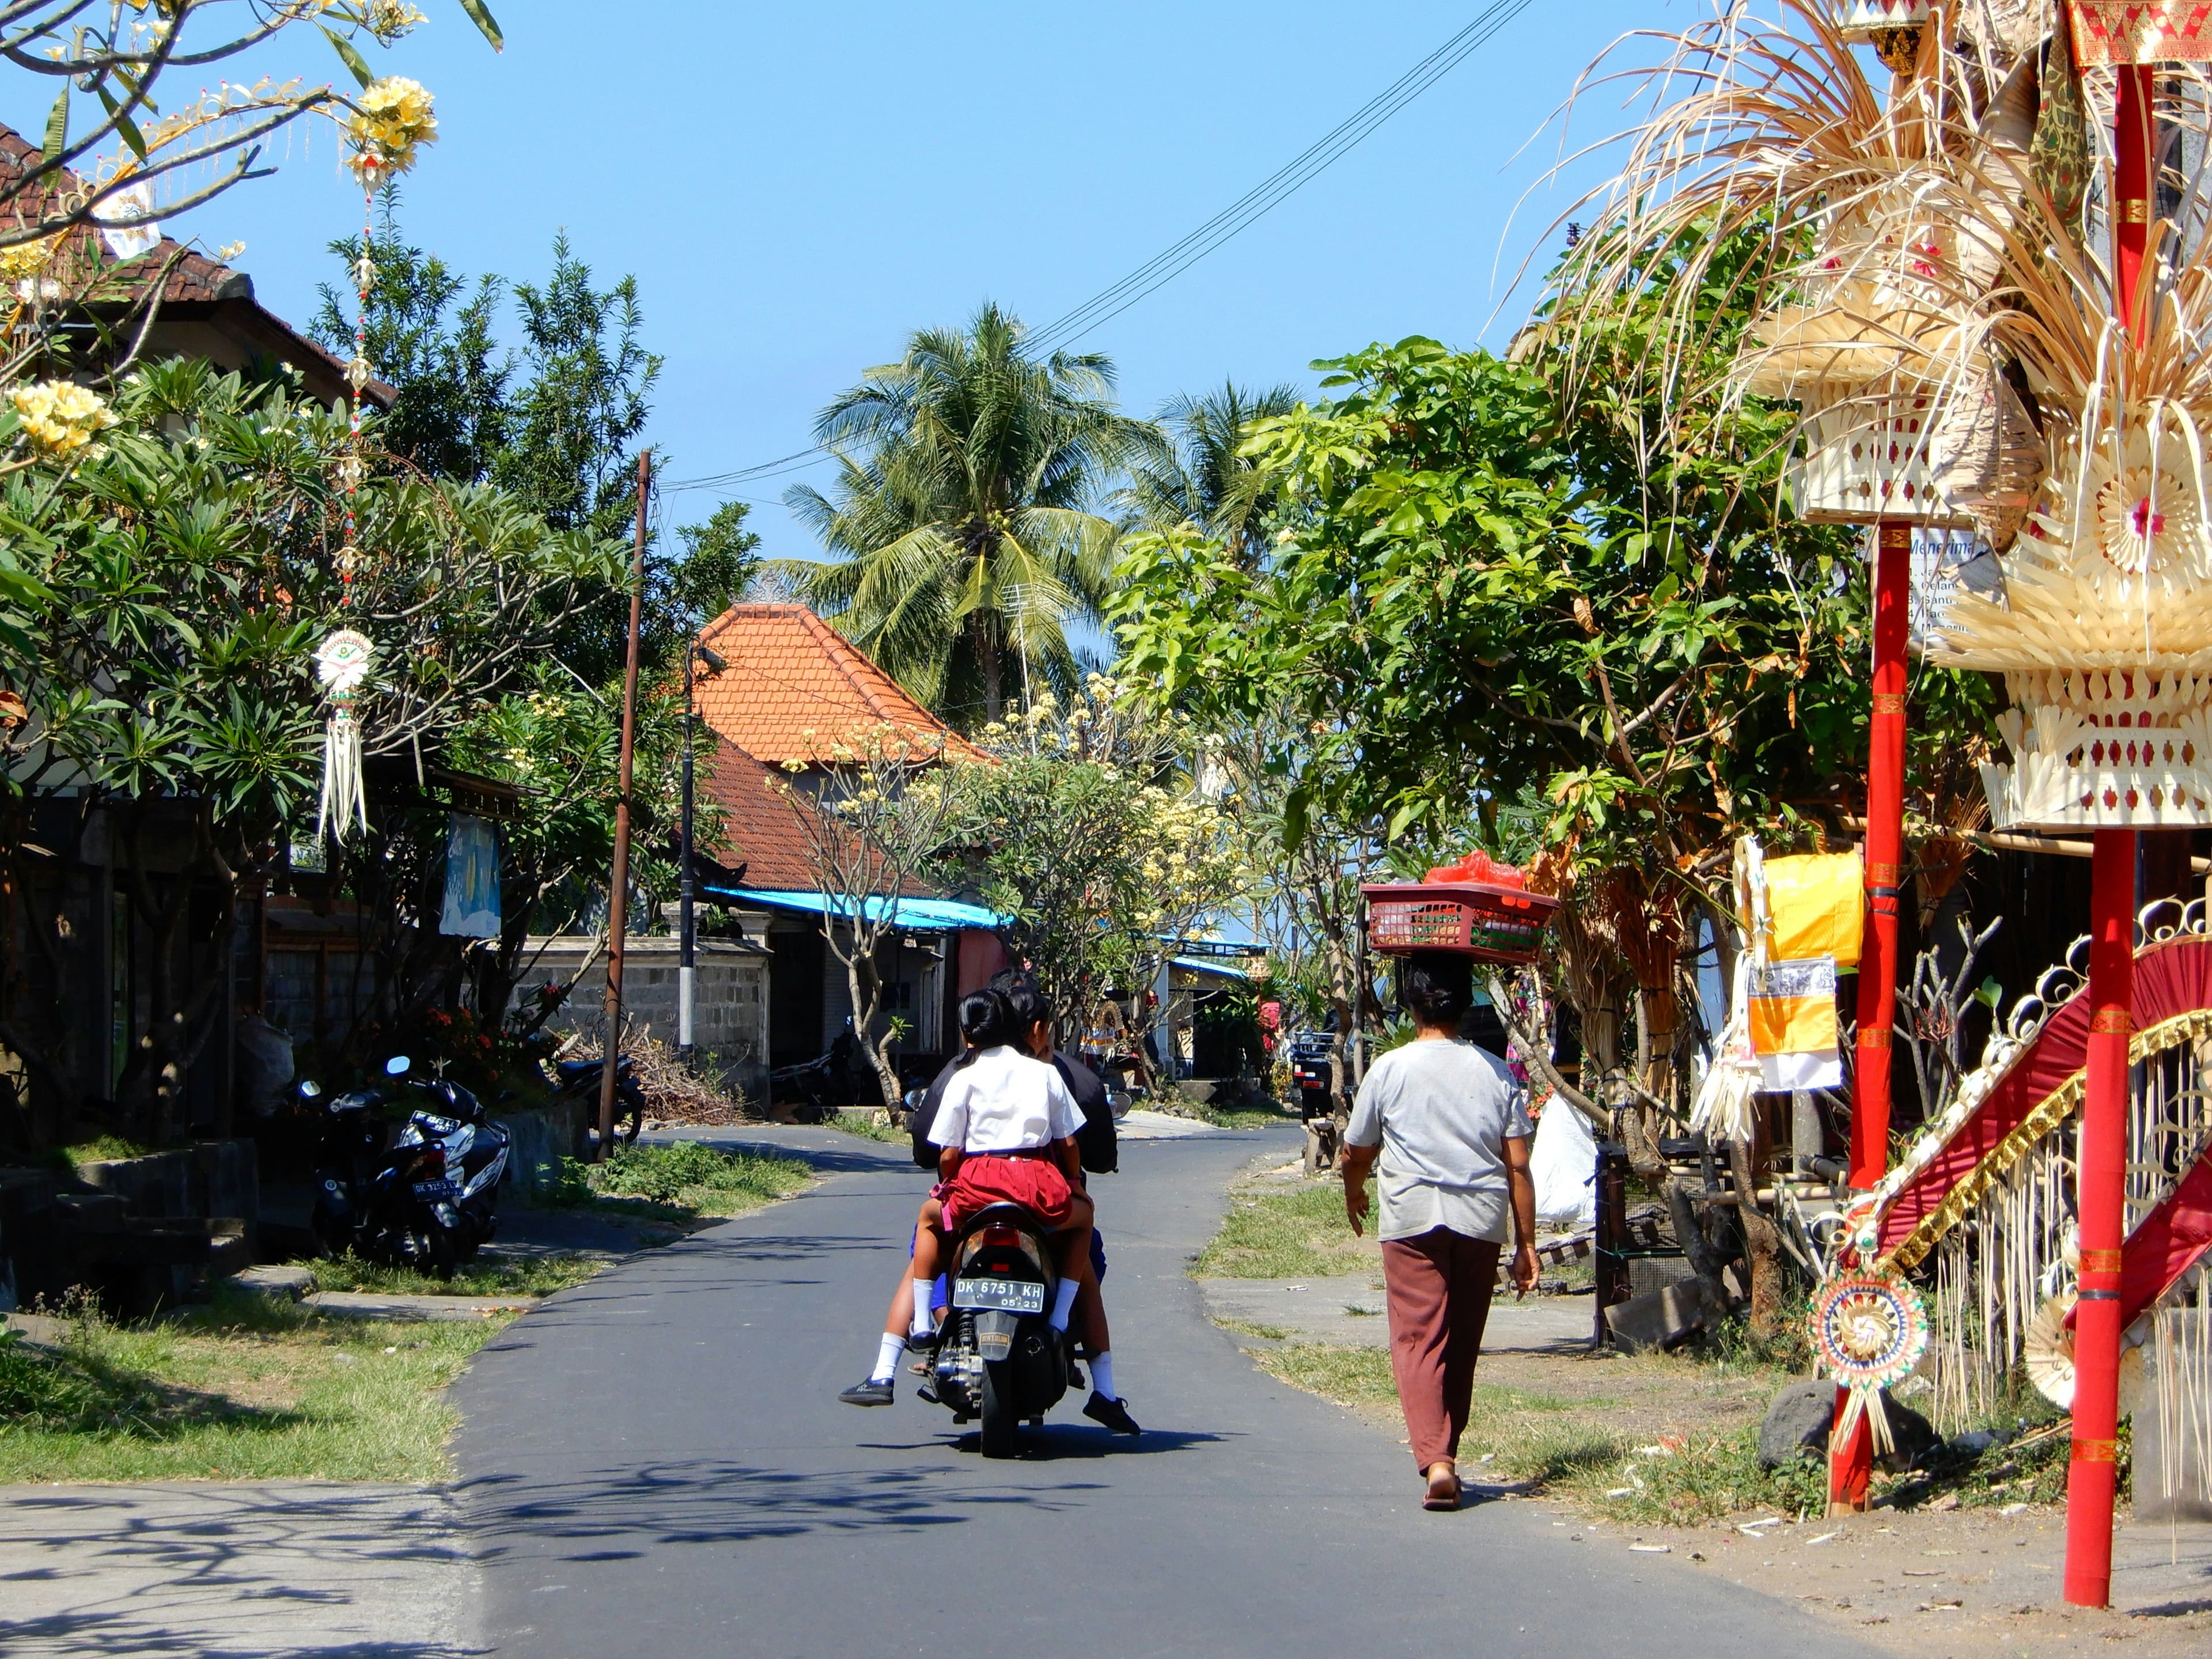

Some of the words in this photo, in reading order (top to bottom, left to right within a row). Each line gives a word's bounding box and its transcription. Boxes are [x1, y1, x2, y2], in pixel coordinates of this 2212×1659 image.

[957, 1281, 975, 1293] DK
[981, 1282, 1014, 1296] 6751
[1022, 1285, 1040, 1298] KH
